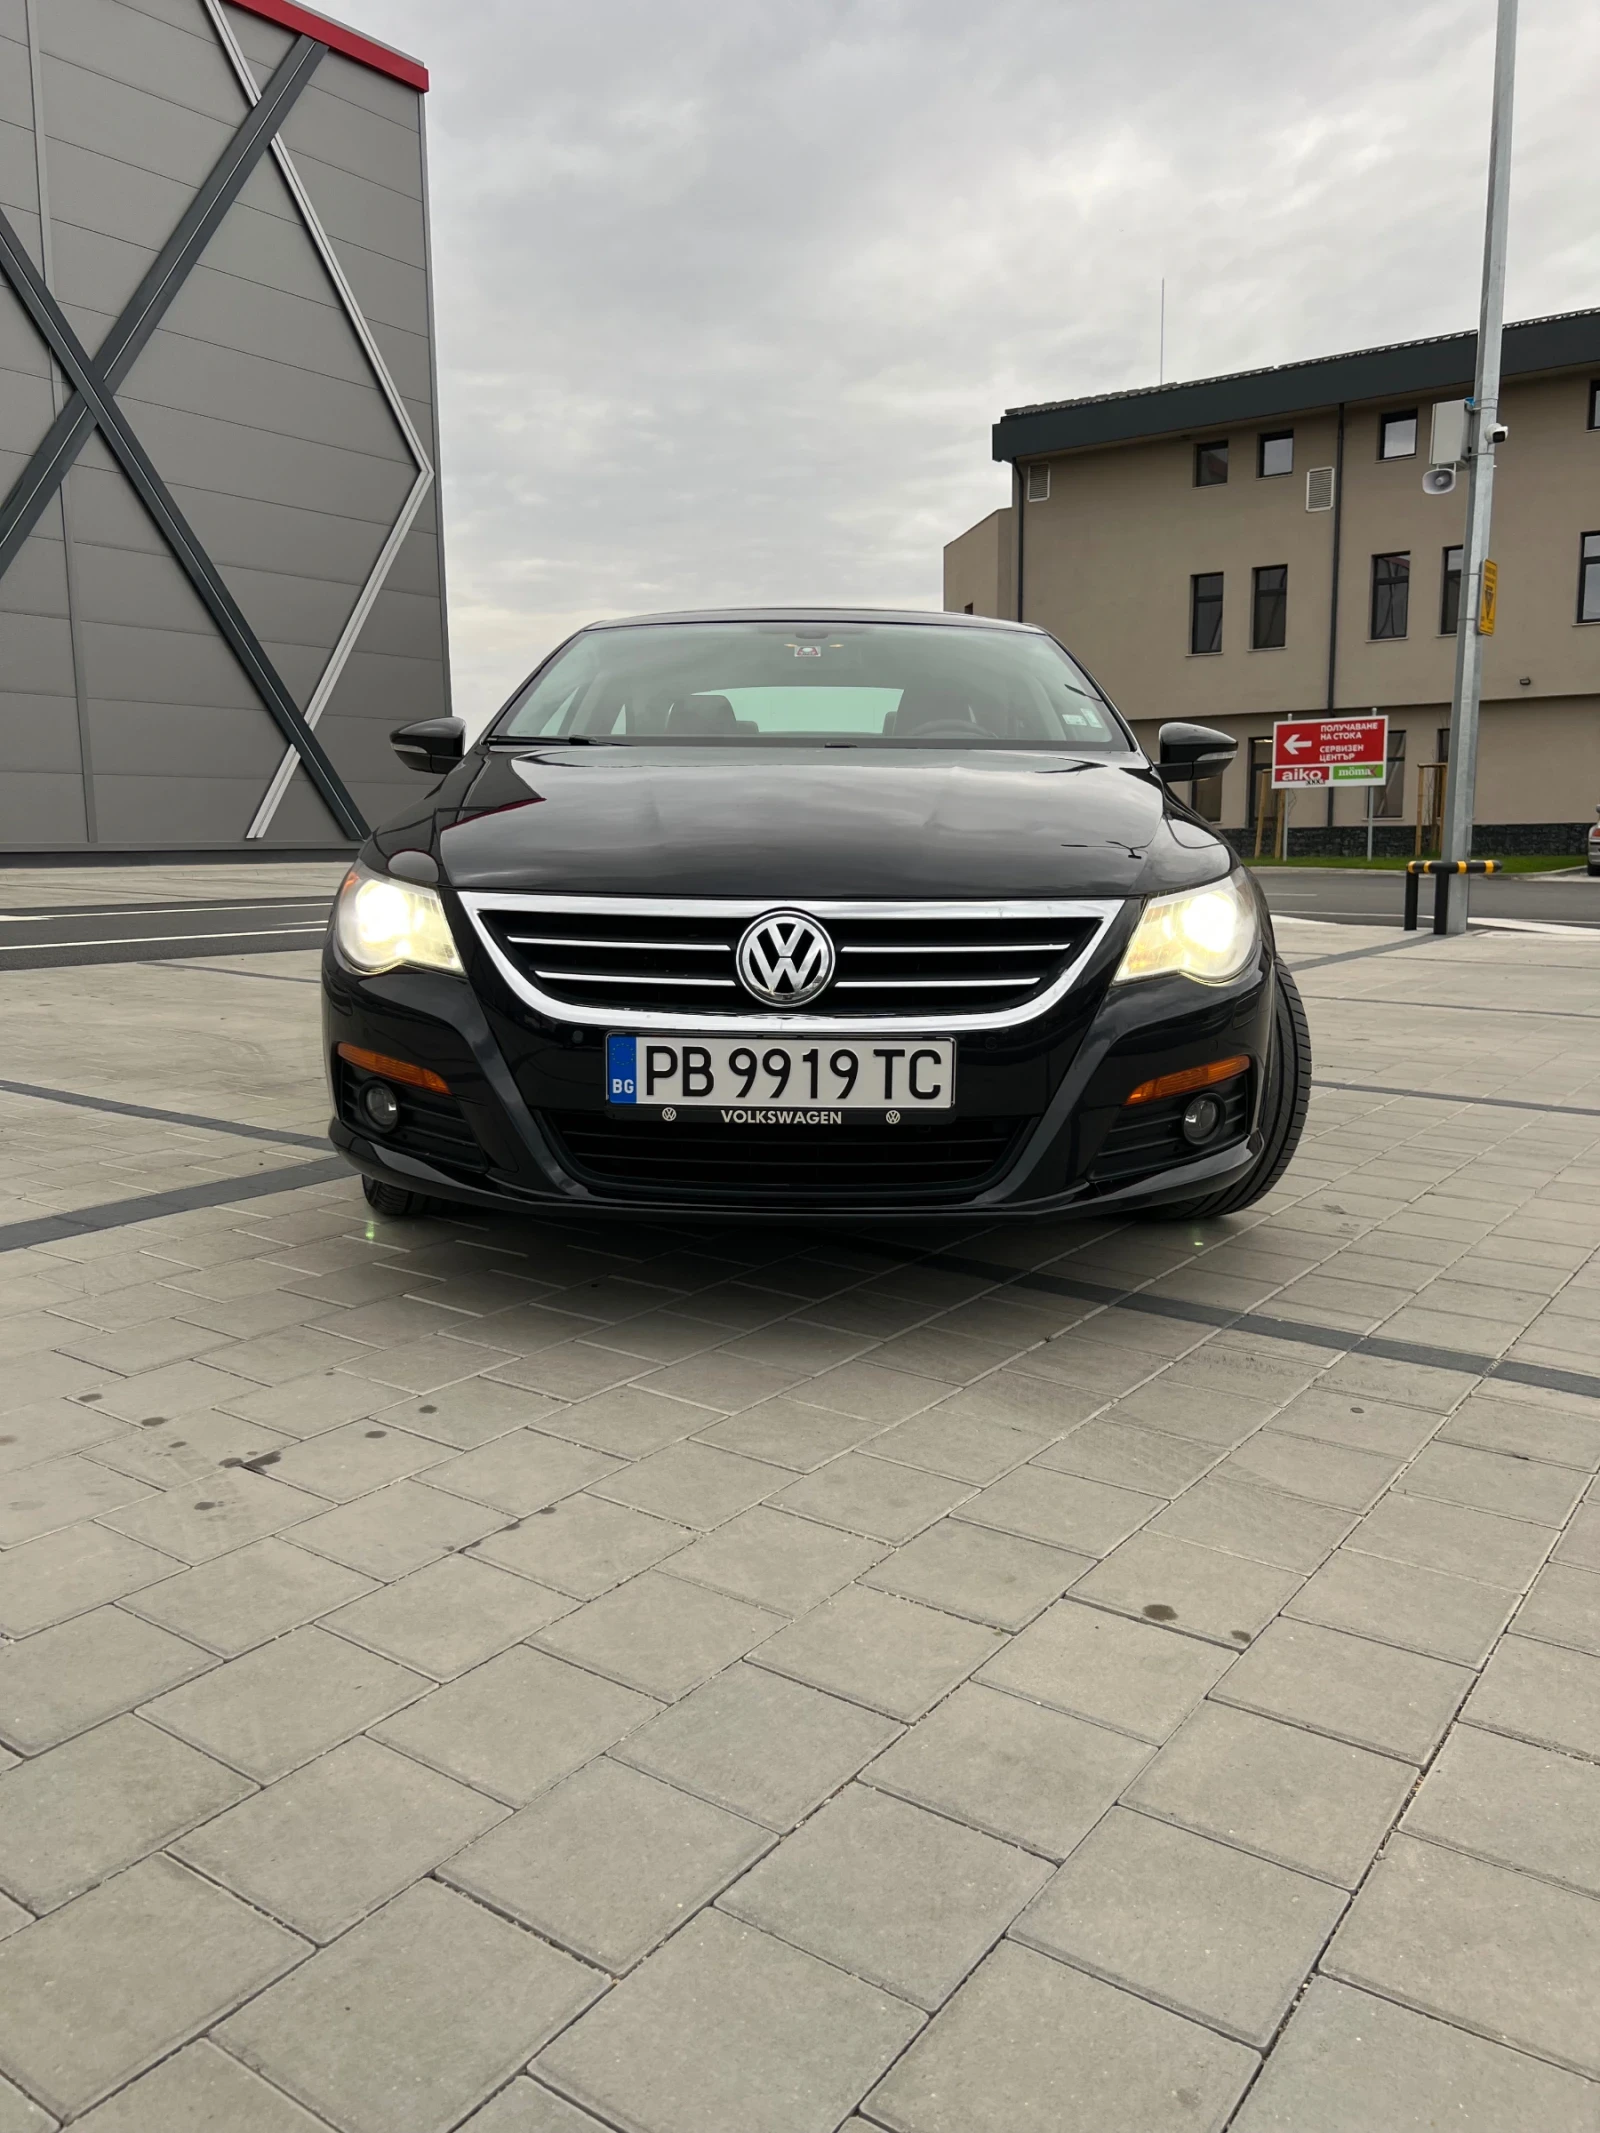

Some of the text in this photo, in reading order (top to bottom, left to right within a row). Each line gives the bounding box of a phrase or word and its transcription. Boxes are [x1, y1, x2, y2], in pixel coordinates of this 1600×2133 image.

[1320, 722, 1378, 732] ПОЛУЧАВАНЕ
[1320, 731, 1362, 741] НА СТОКА
[1319, 744, 1364, 753] СЕРВИЗЕН
[1319, 753, 1355, 763] ЦЕНТЪР
[1282, 768, 1322, 781] aiko
[737, 911, 835, 1007] VW
[646, 1045, 942, 1100] PB 9919 TC
[612, 1079, 635, 1094] BG
[661, 1107, 677, 1122] VW
[721, 1109, 842, 1125] VOLKSWAGEN
[885, 1109, 901, 1125] VW
